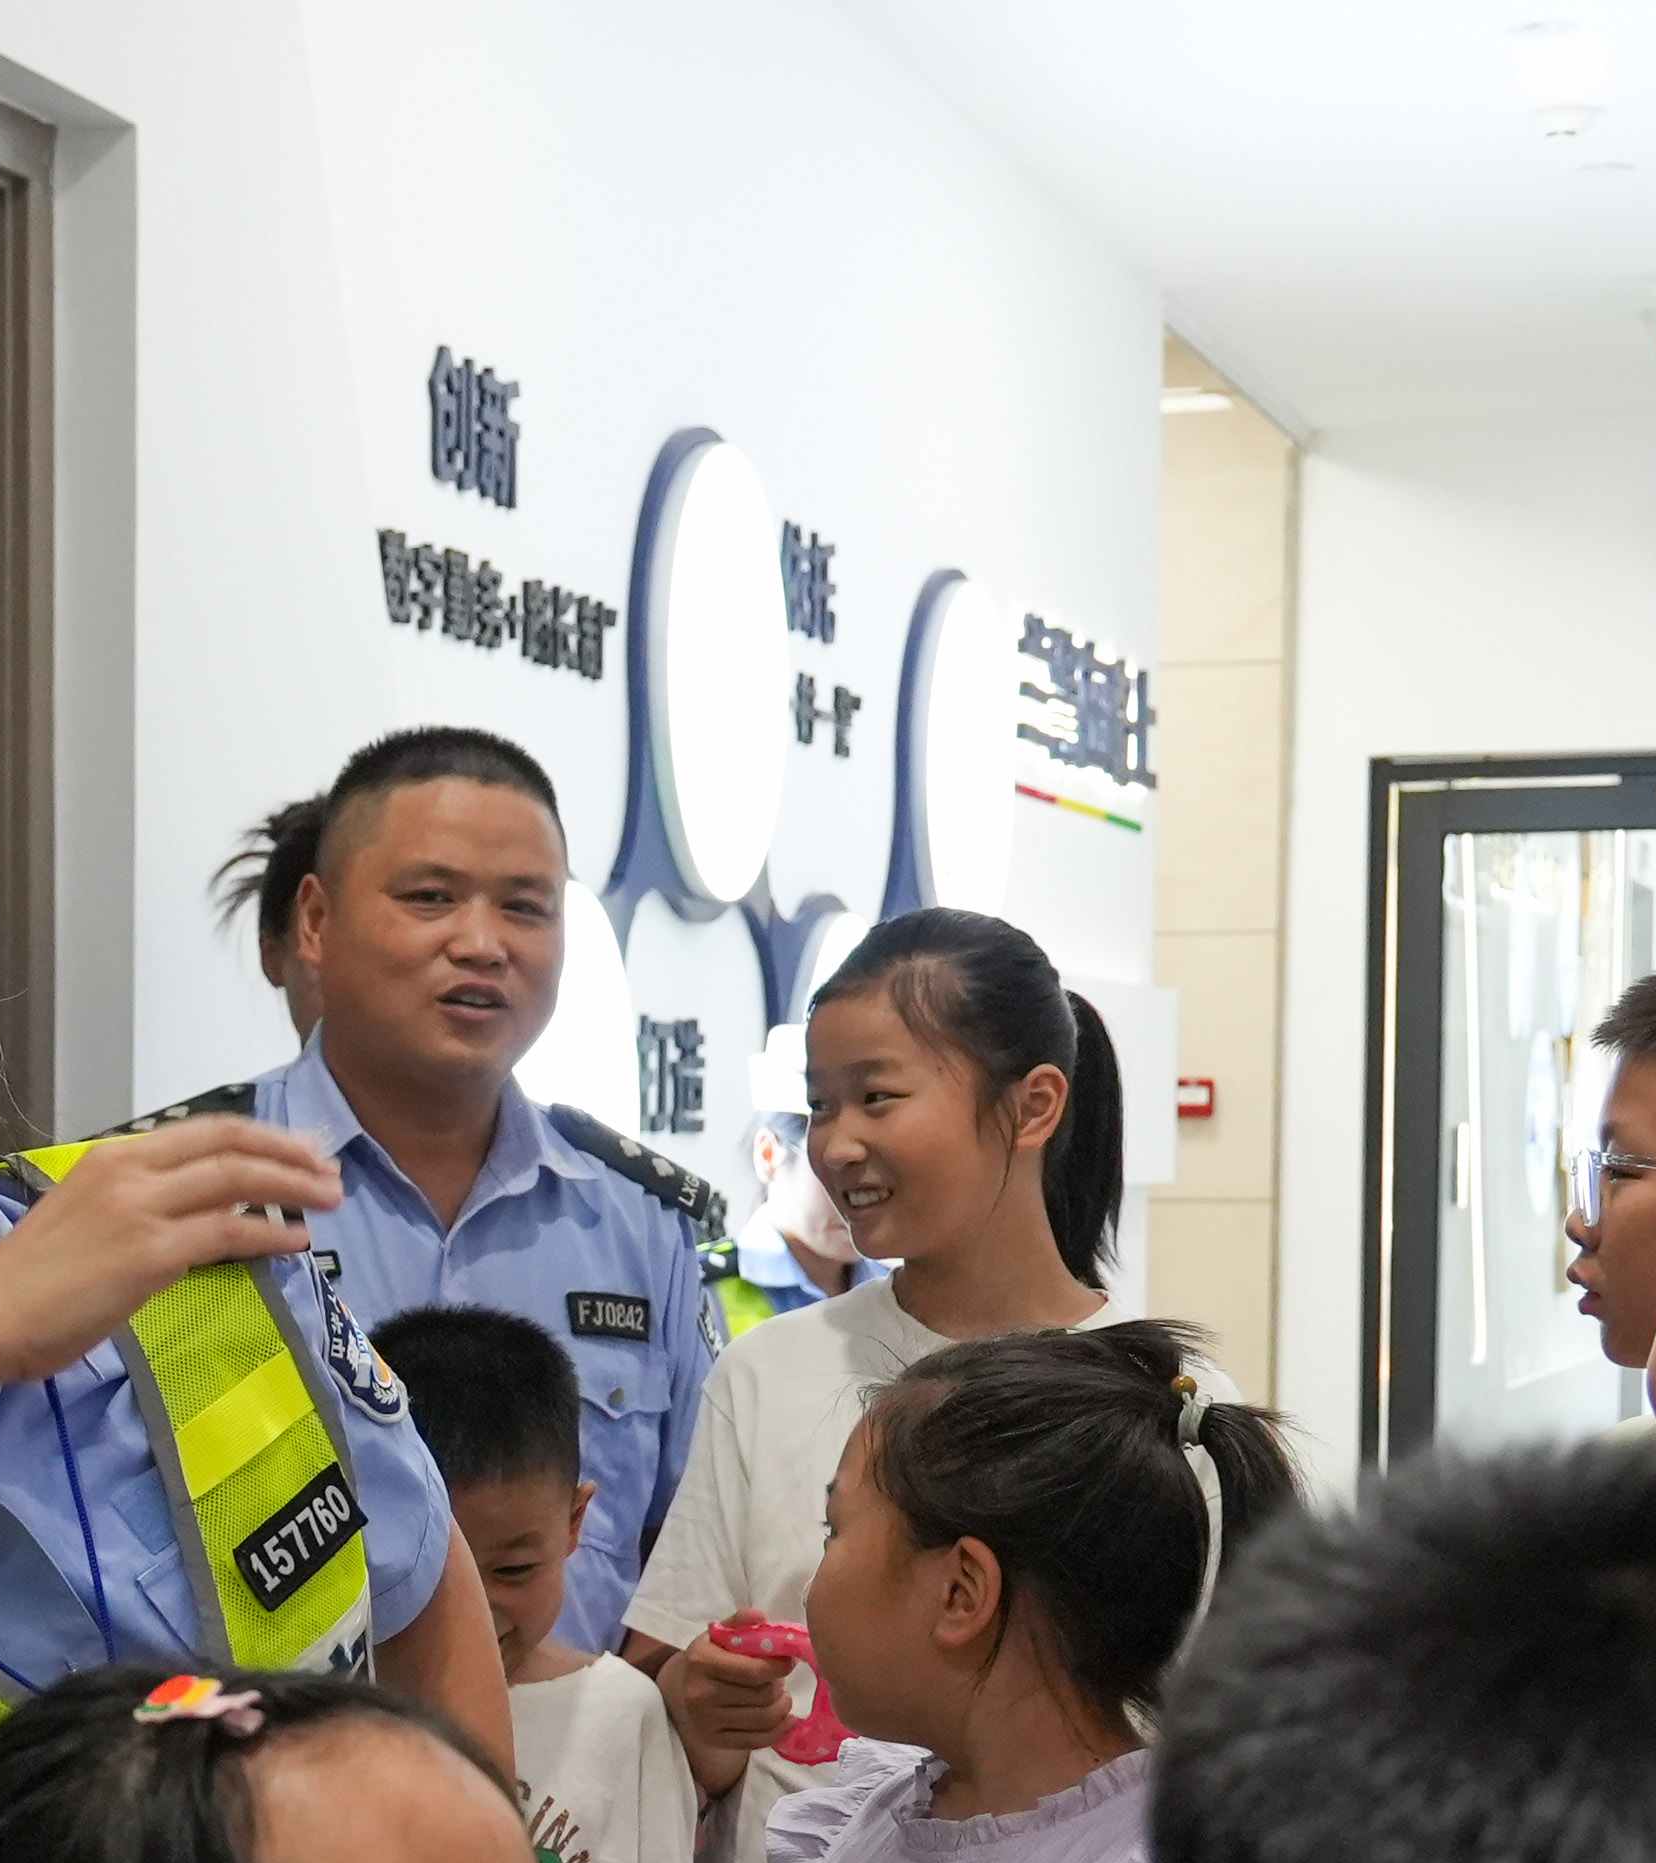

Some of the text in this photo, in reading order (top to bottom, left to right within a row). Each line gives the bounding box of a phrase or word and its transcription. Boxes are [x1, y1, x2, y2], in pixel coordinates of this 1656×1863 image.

[428, 345, 520, 508] 创新
[577, 1300, 645, 1333] FJ0842
[249, 1484, 352, 1593] 157760
